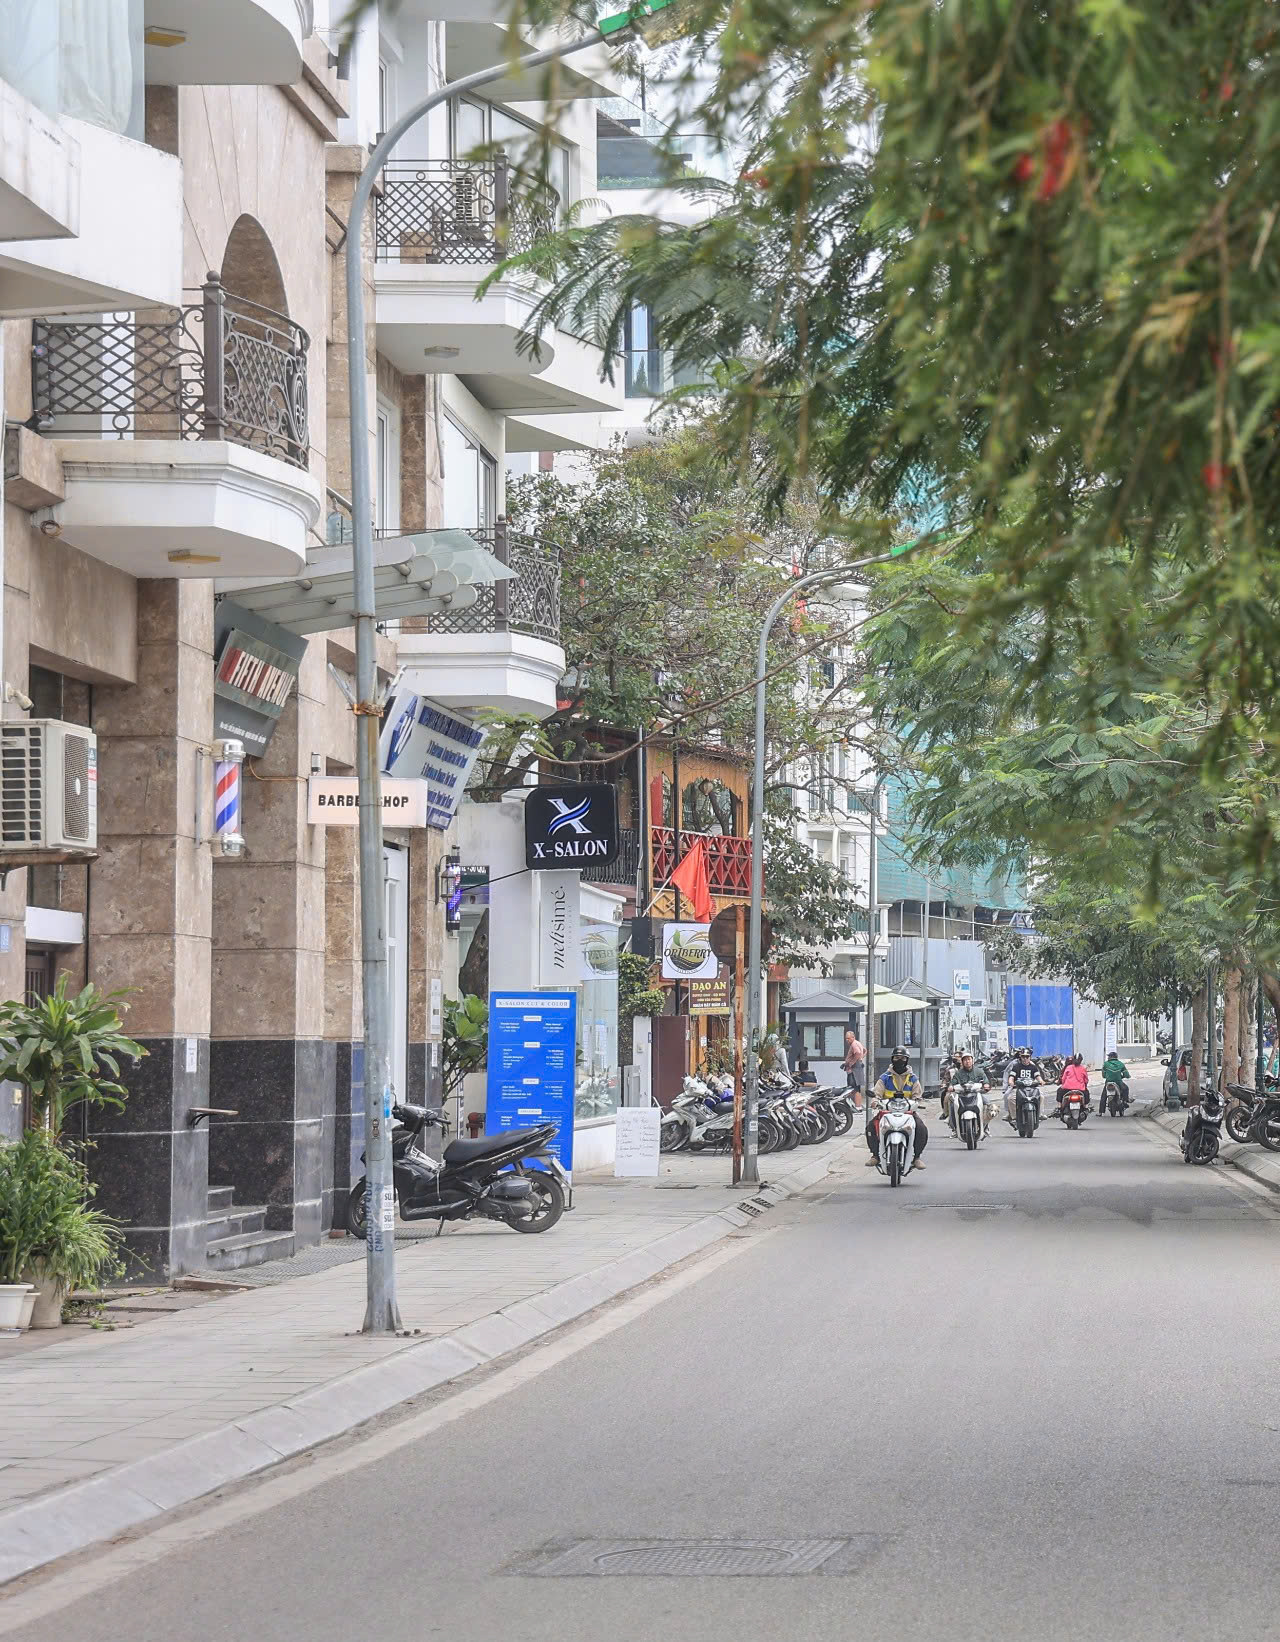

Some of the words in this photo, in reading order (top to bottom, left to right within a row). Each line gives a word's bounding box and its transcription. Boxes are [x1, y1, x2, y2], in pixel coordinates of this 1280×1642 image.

[228, 650, 265, 696] FIFTH
[259, 665, 297, 707] AVENUE
[318, 794, 360, 807] BARBE
[380, 796, 409, 808] HOP
[533, 839, 609, 859] X-SALON
[692, 982, 712, 993] ĐẠO
[713, 981, 727, 990] AN
